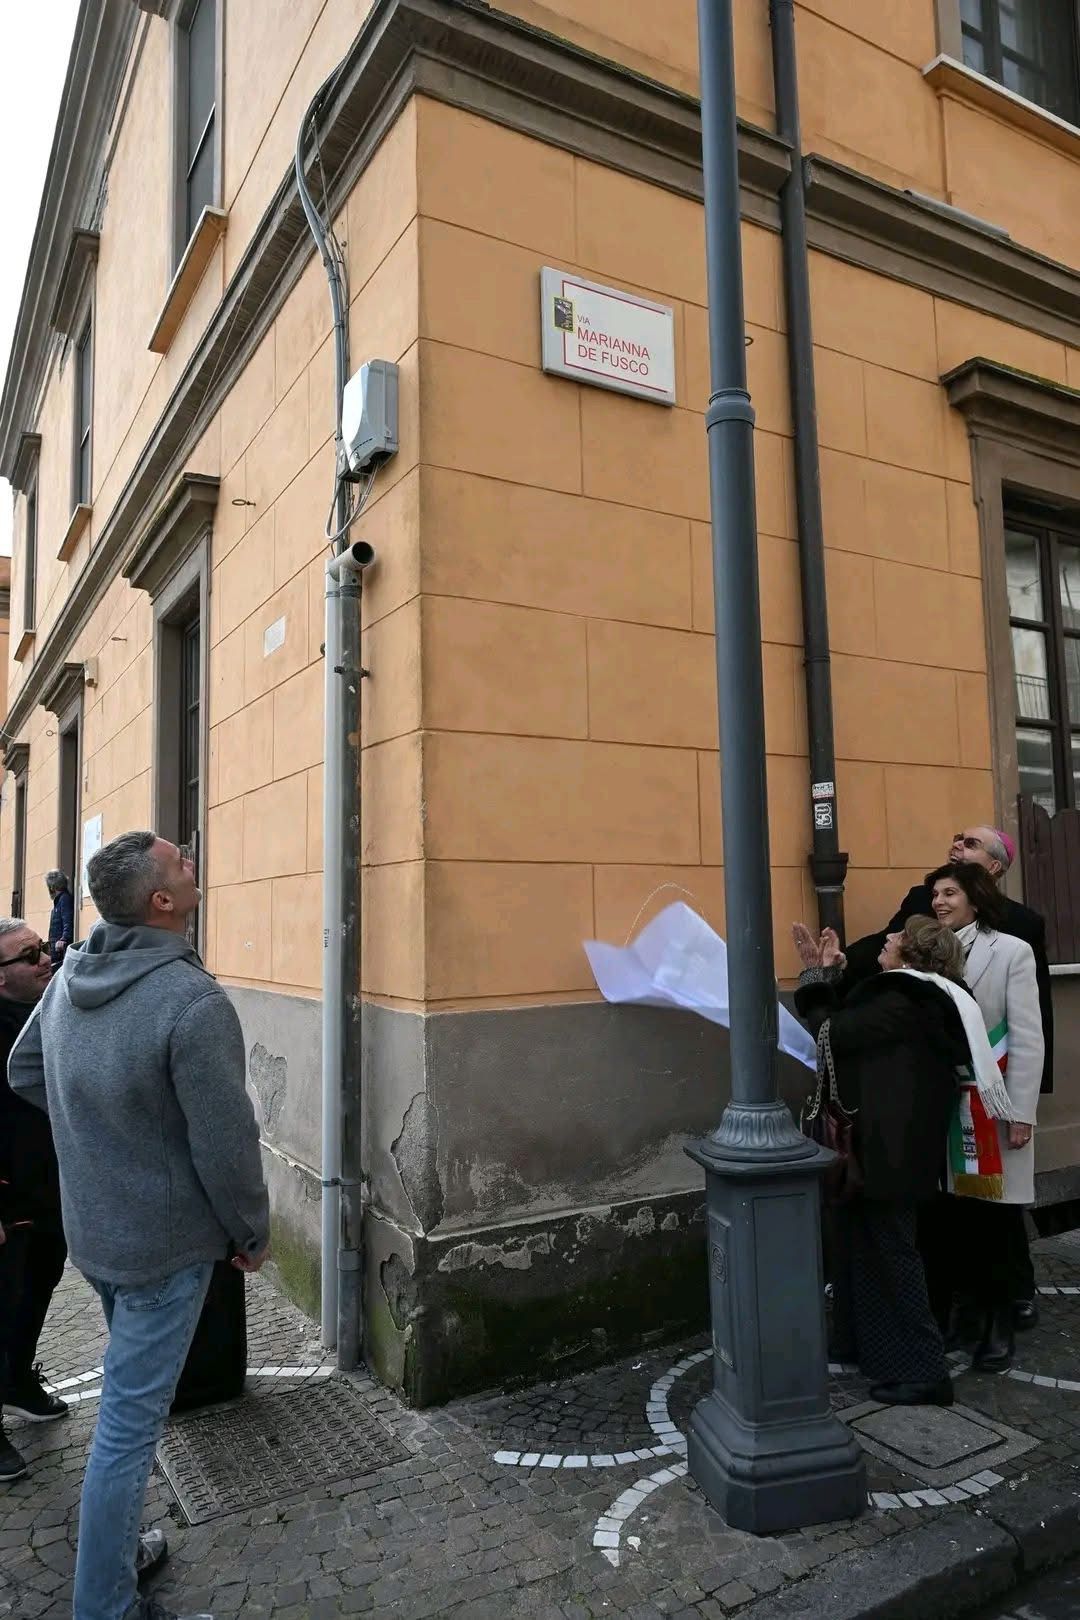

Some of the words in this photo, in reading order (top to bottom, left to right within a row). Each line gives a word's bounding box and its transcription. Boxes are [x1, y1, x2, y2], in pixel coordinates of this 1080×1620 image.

[577, 315, 591, 325] VIA
[577, 326, 651, 360] MARIANNA
[578, 344, 597, 361] DE
[601, 351, 649, 376] FUSCO
